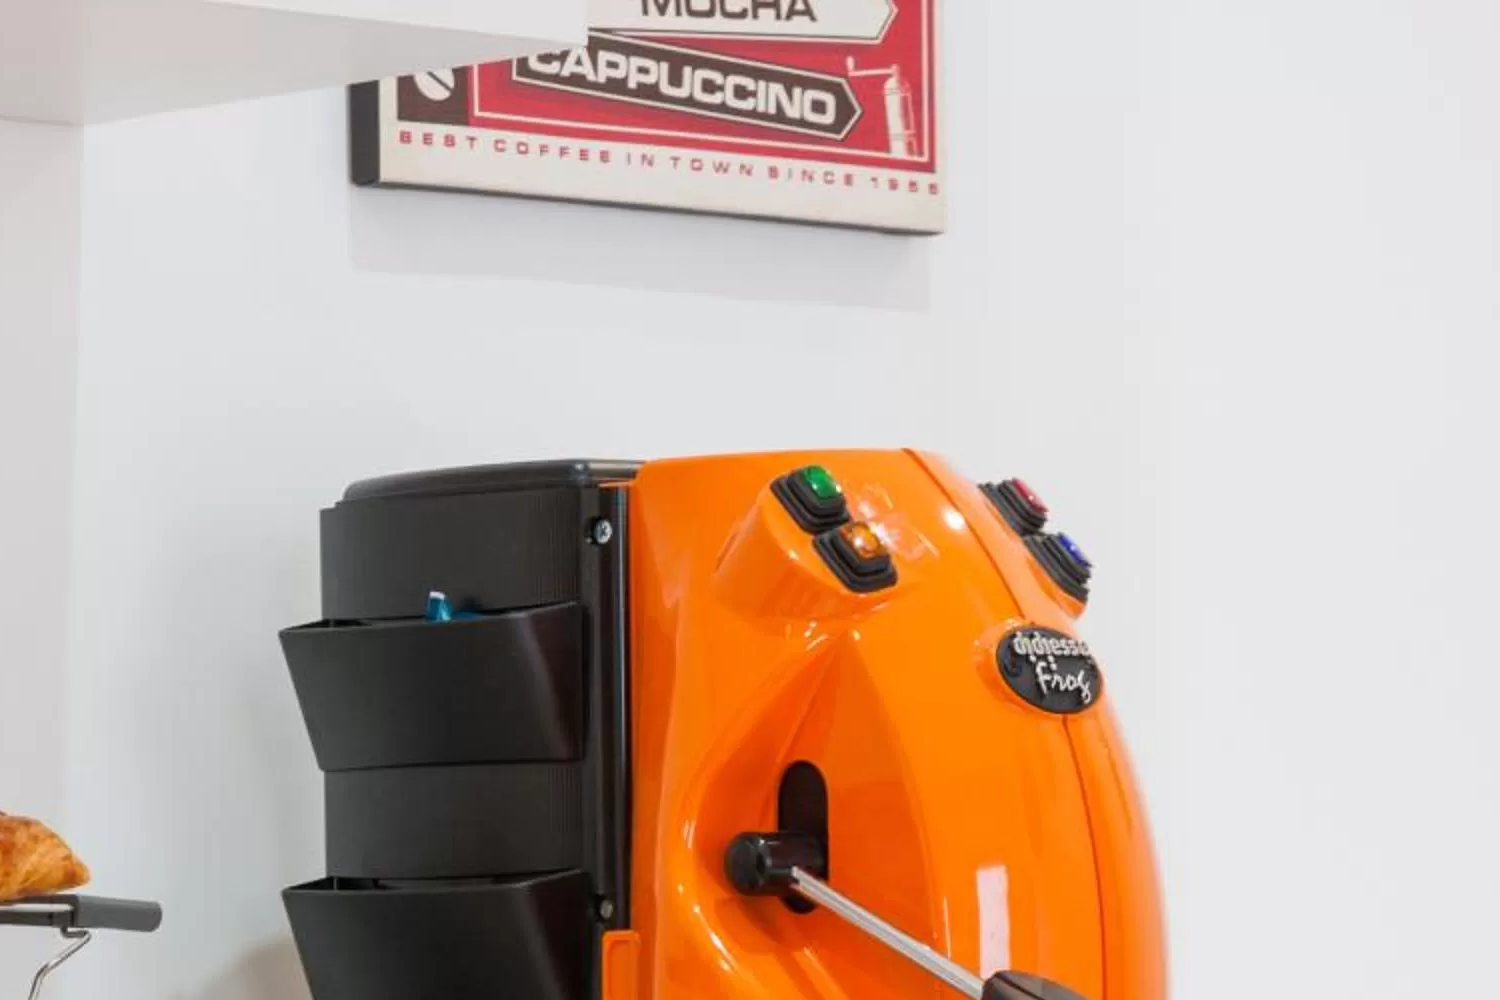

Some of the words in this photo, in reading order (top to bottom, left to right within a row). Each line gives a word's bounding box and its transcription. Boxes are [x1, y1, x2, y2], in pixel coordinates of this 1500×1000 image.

[641, 0, 818, 22] MOCHA
[527, 47, 837, 126] CAPPUCCINO
[399, 129, 478, 149] BEST
[493, 138, 612, 163] COFFEE
[626, 151, 655, 167] IN
[669, 155, 753, 177] TOWN
[767, 165, 855, 186] SINCE
[1035, 660, 1092, 705] Frog
